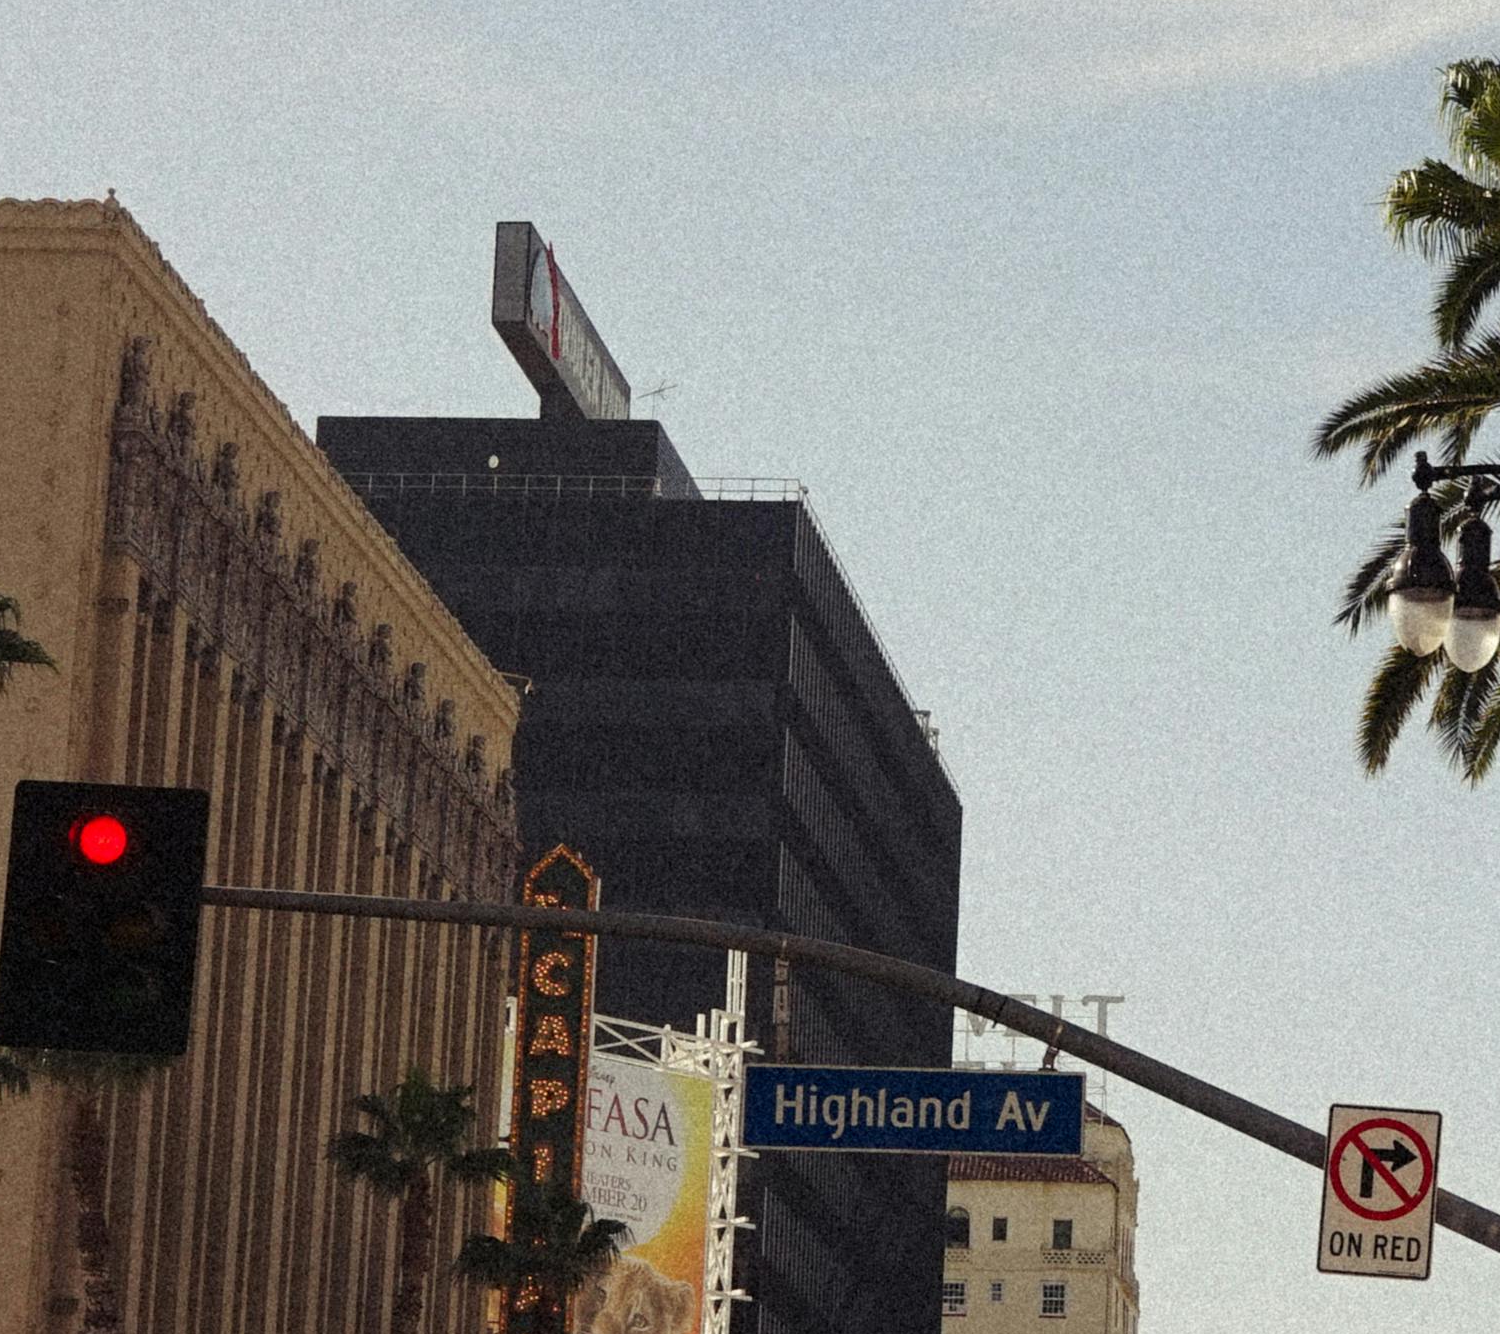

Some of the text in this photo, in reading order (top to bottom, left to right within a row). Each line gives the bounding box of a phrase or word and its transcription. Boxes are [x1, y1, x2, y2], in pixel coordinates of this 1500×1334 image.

[585, 1087, 679, 1148] FASA
[774, 1084, 1051, 1140] Highland Av
[626, 1145, 679, 1173] KING
[630, 1192, 648, 1213] 20
[1329, 1230, 1422, 1263] ON RED
